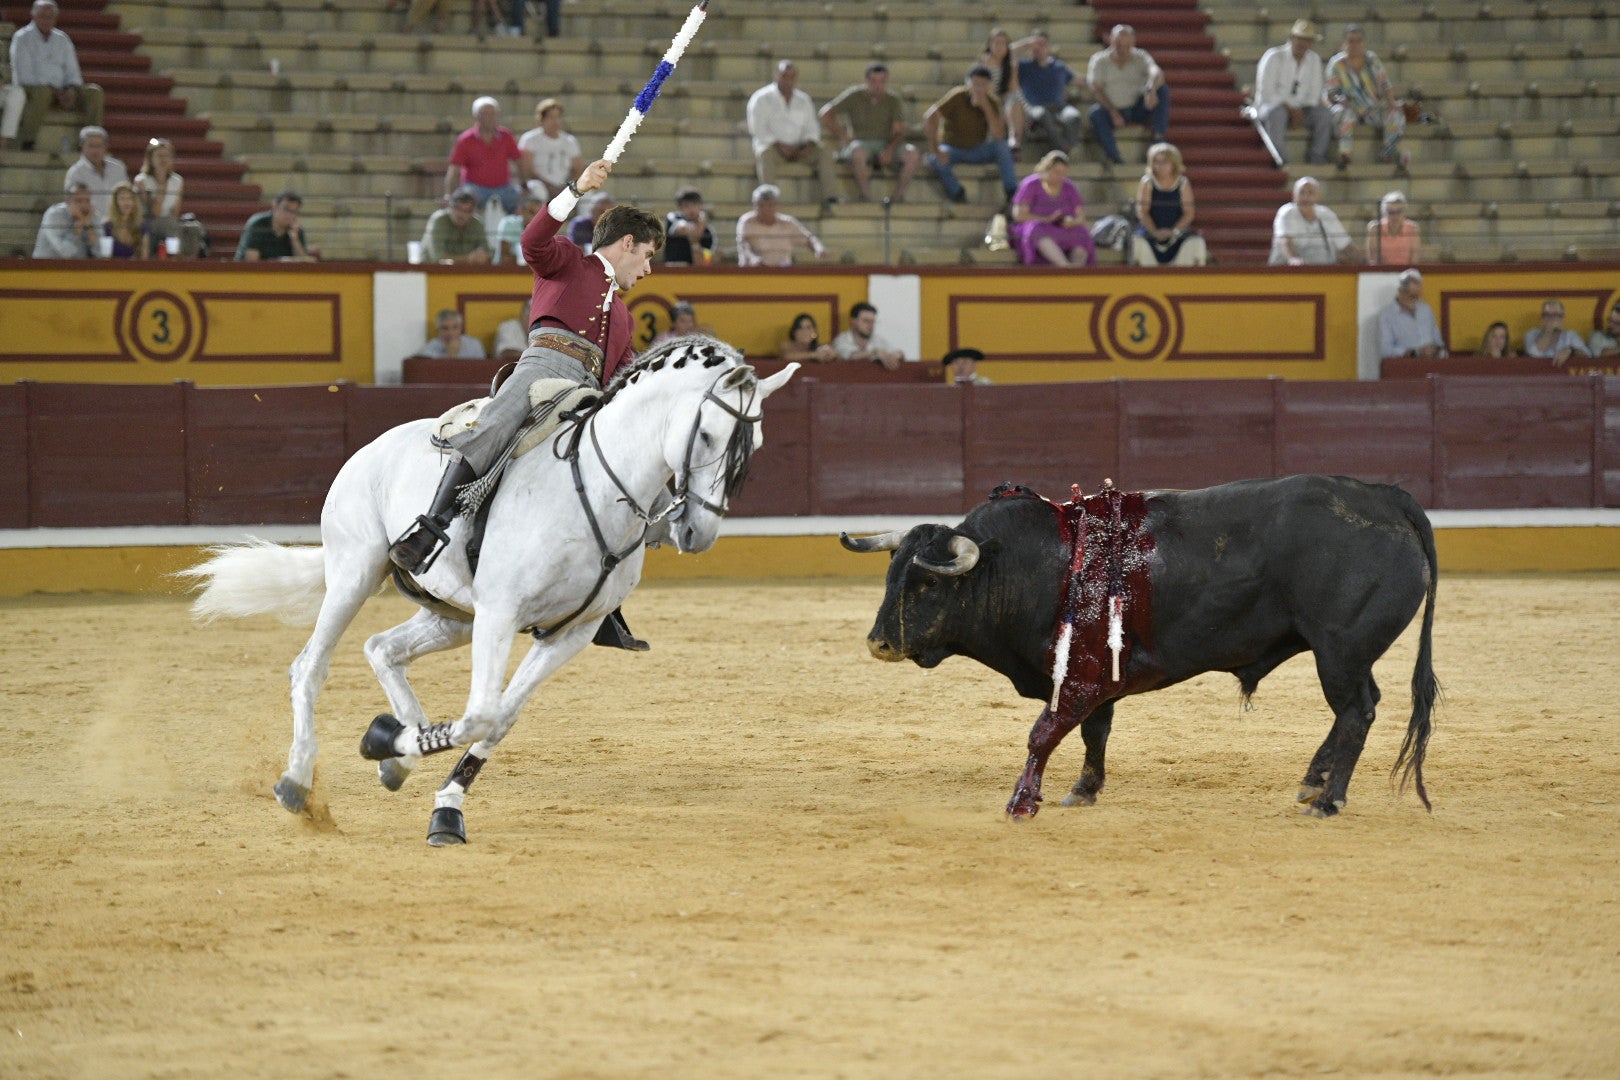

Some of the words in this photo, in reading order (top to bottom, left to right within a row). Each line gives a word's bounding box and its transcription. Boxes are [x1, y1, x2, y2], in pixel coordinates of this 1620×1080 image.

[152, 309, 170, 344] 3
[640, 311, 657, 344] 3
[1129, 311, 1149, 344] 3
